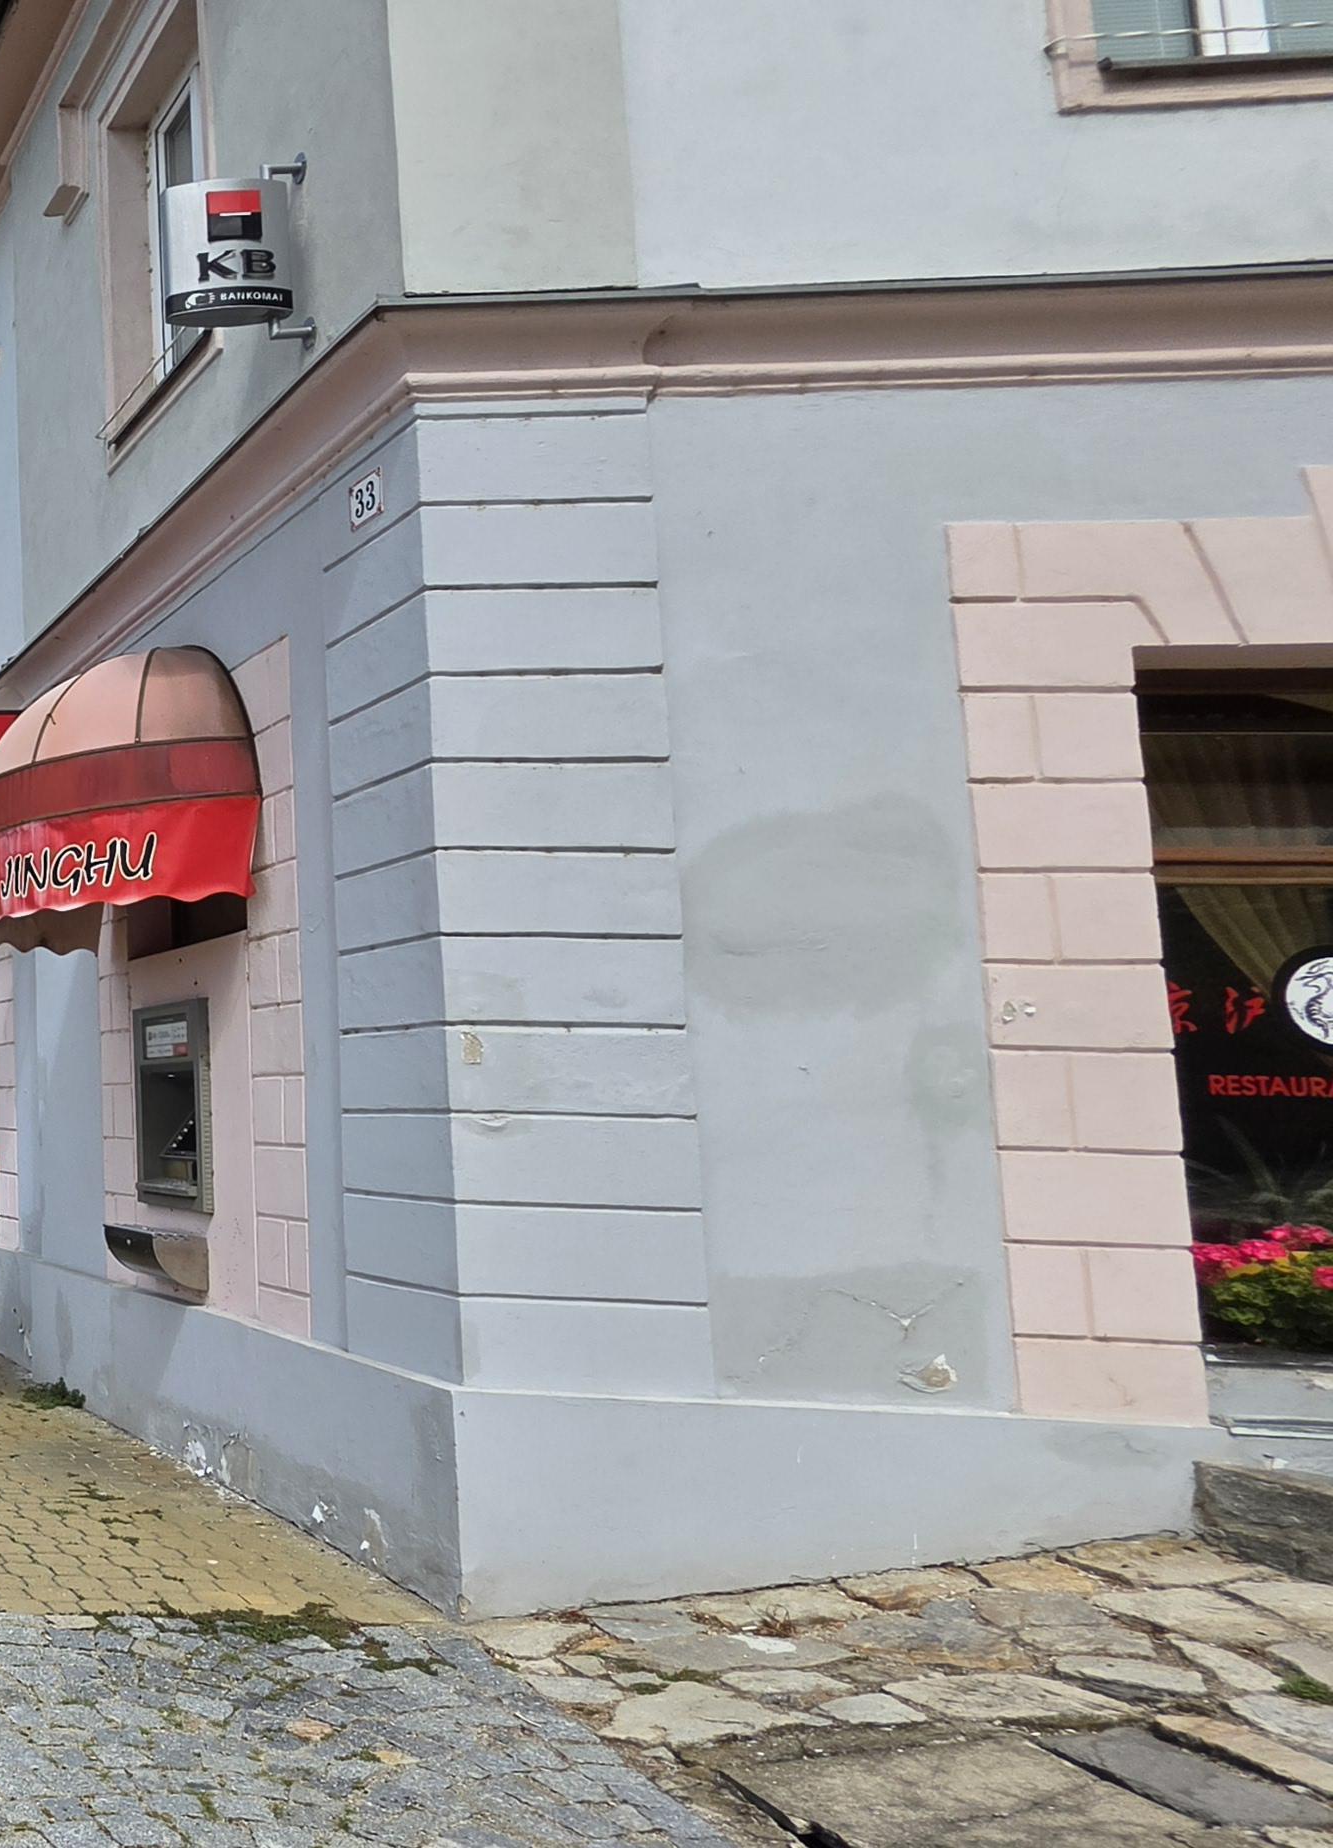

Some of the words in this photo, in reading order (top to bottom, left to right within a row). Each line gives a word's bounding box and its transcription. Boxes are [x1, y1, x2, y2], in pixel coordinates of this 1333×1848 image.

[196, 249, 277, 283] KB
[355, 480, 376, 519] 33
[0, 831, 159, 900] JINGHU
